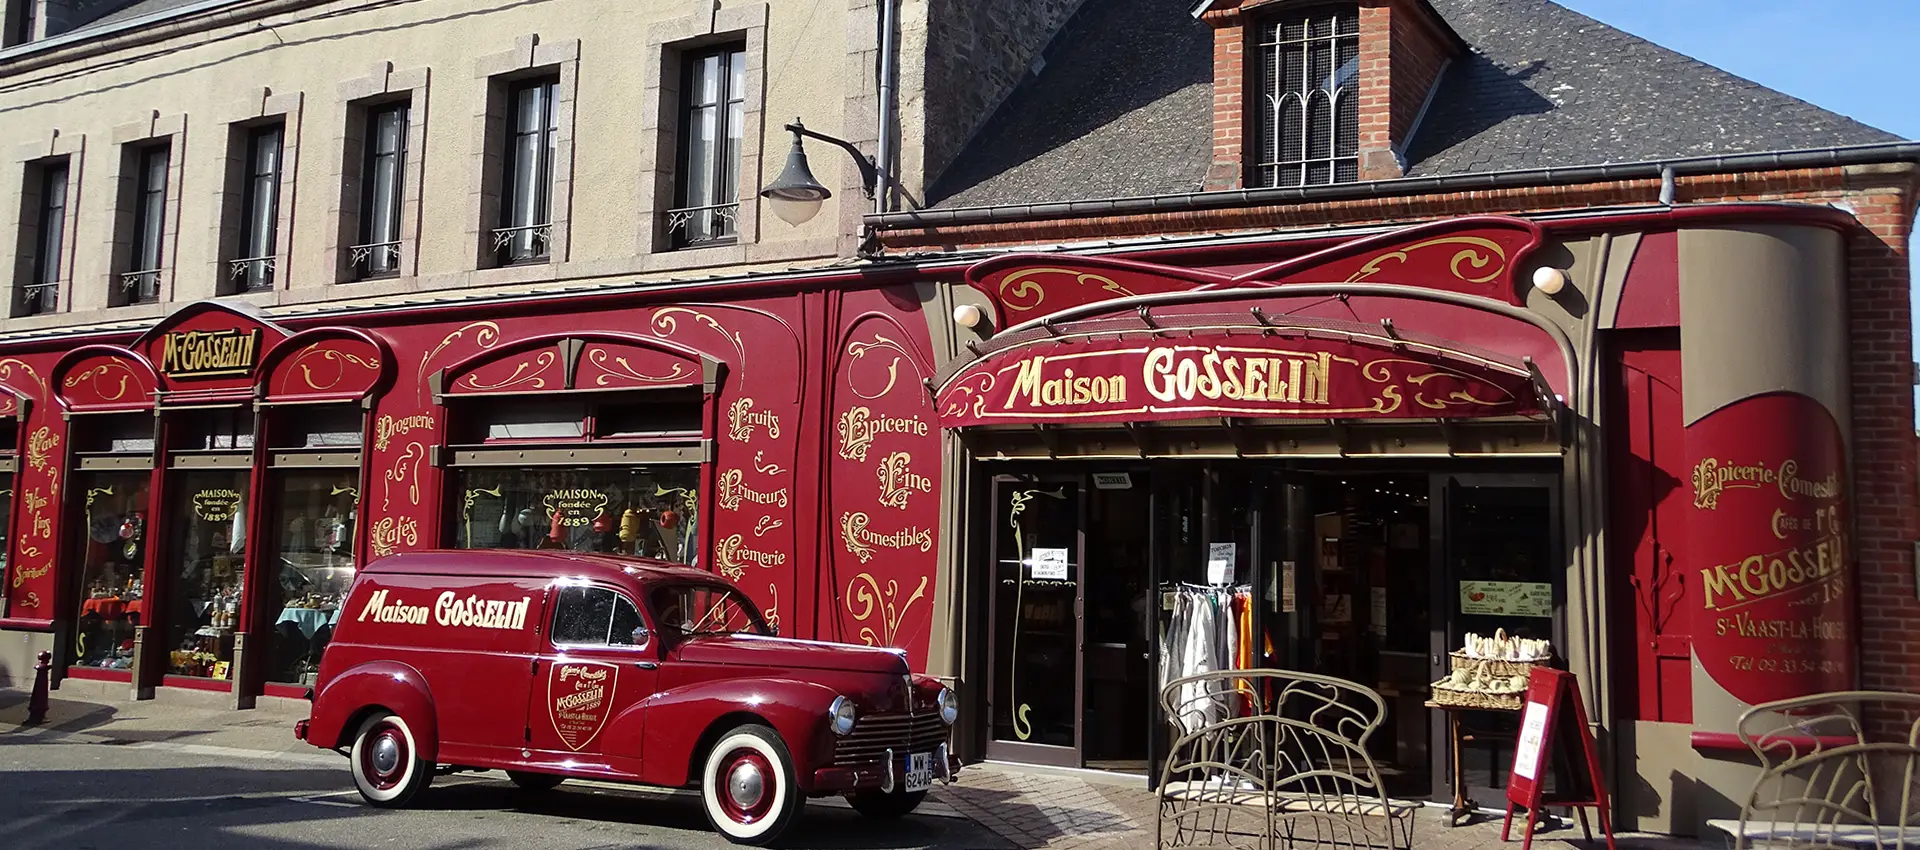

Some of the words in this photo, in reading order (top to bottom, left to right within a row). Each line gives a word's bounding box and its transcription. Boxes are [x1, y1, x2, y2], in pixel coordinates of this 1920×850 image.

[1003, 355, 1128, 410] Maison
[1143, 347, 1331, 406] GOSSELIN
[374, 411, 435, 452] Droguerie
[728, 397, 781, 443] Fruits
[837, 406, 928, 462] Epicerie
[28, 426, 60, 471] Cave
[25, 487, 47, 514] Vins
[201, 490, 234, 498] MAISON
[553, 489, 598, 499] MAISON
[718, 468, 788, 511] Primeurs
[876, 451, 932, 510] Fine
[33, 511, 51, 539] fins
[203, 513, 228, 521] 1889
[371, 515, 418, 556] Cafés
[558, 517, 590, 527] 1889
[839, 511, 932, 564] Comestibles
[716, 533, 786, 582] Crèmerie
[357, 589, 430, 625] Maison
[434, 590, 532, 630] GOSSELIN
